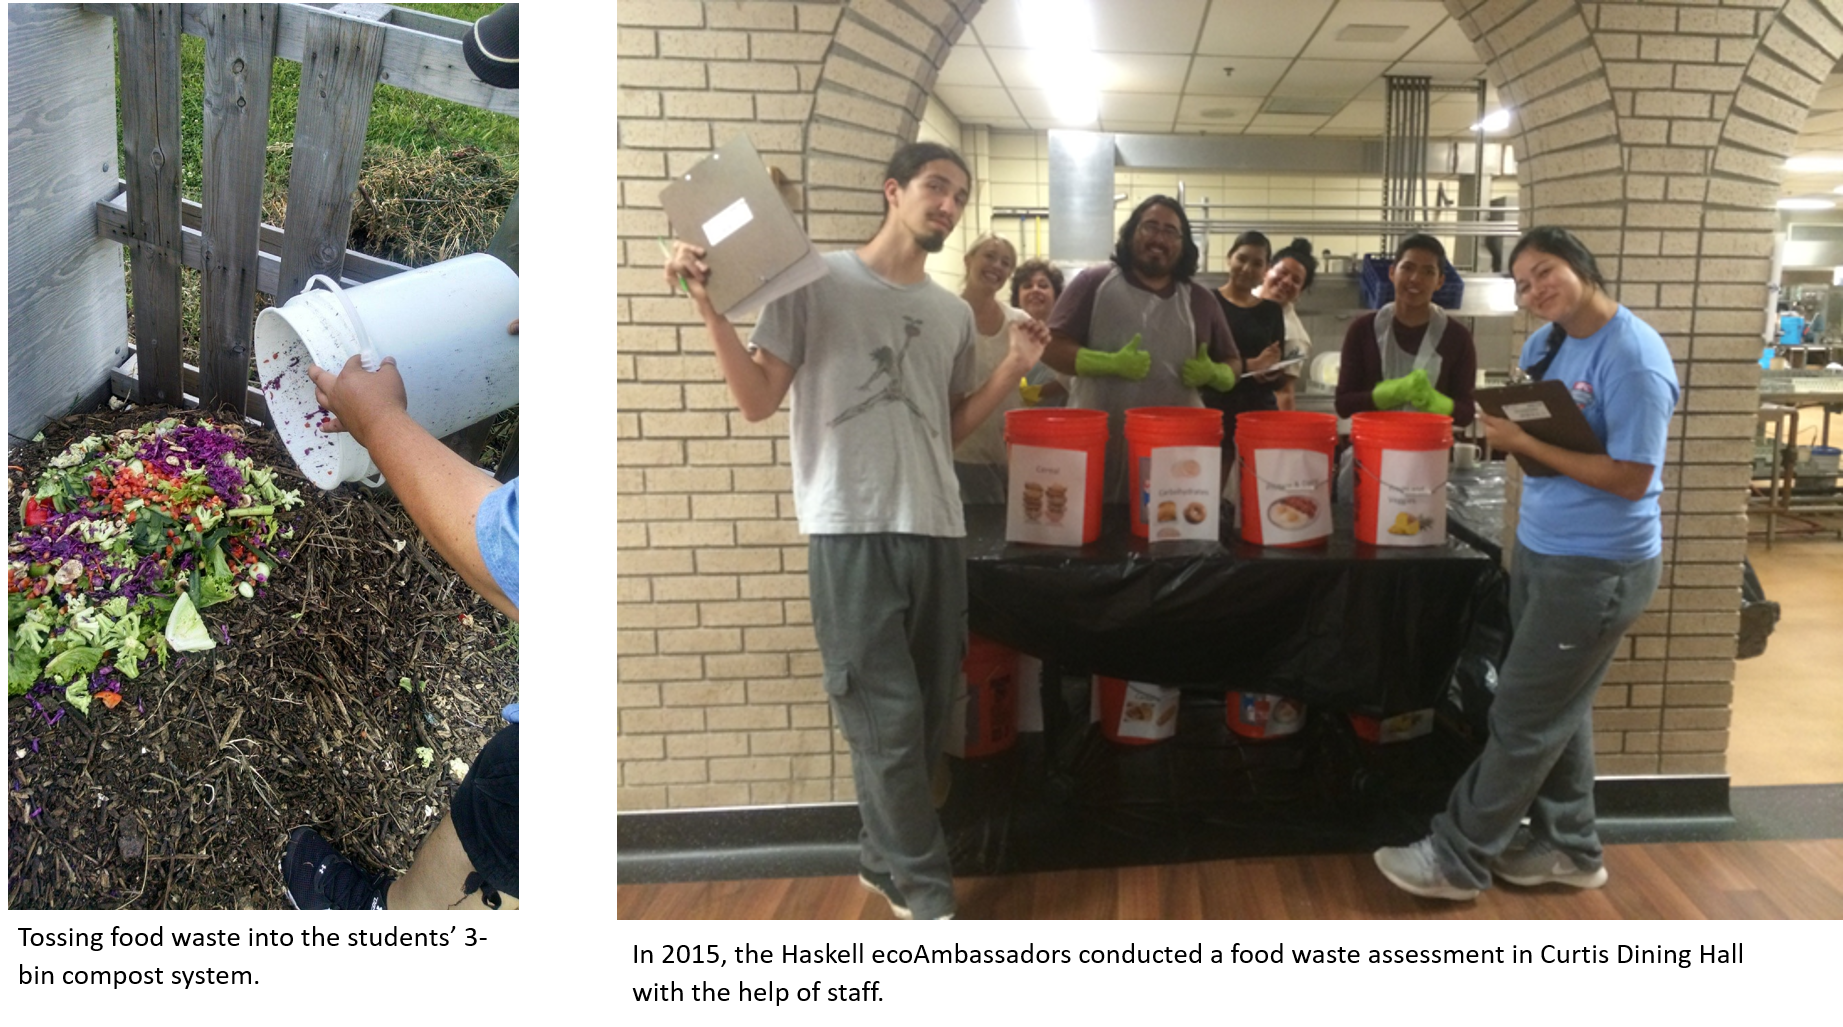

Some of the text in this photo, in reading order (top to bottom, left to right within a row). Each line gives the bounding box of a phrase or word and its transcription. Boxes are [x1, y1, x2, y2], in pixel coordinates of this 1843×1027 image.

[1035, 464, 1061, 476] Cereal
[1158, 486, 1210, 498] Carbohydrates
[1387, 497, 1417, 506] Veggies
